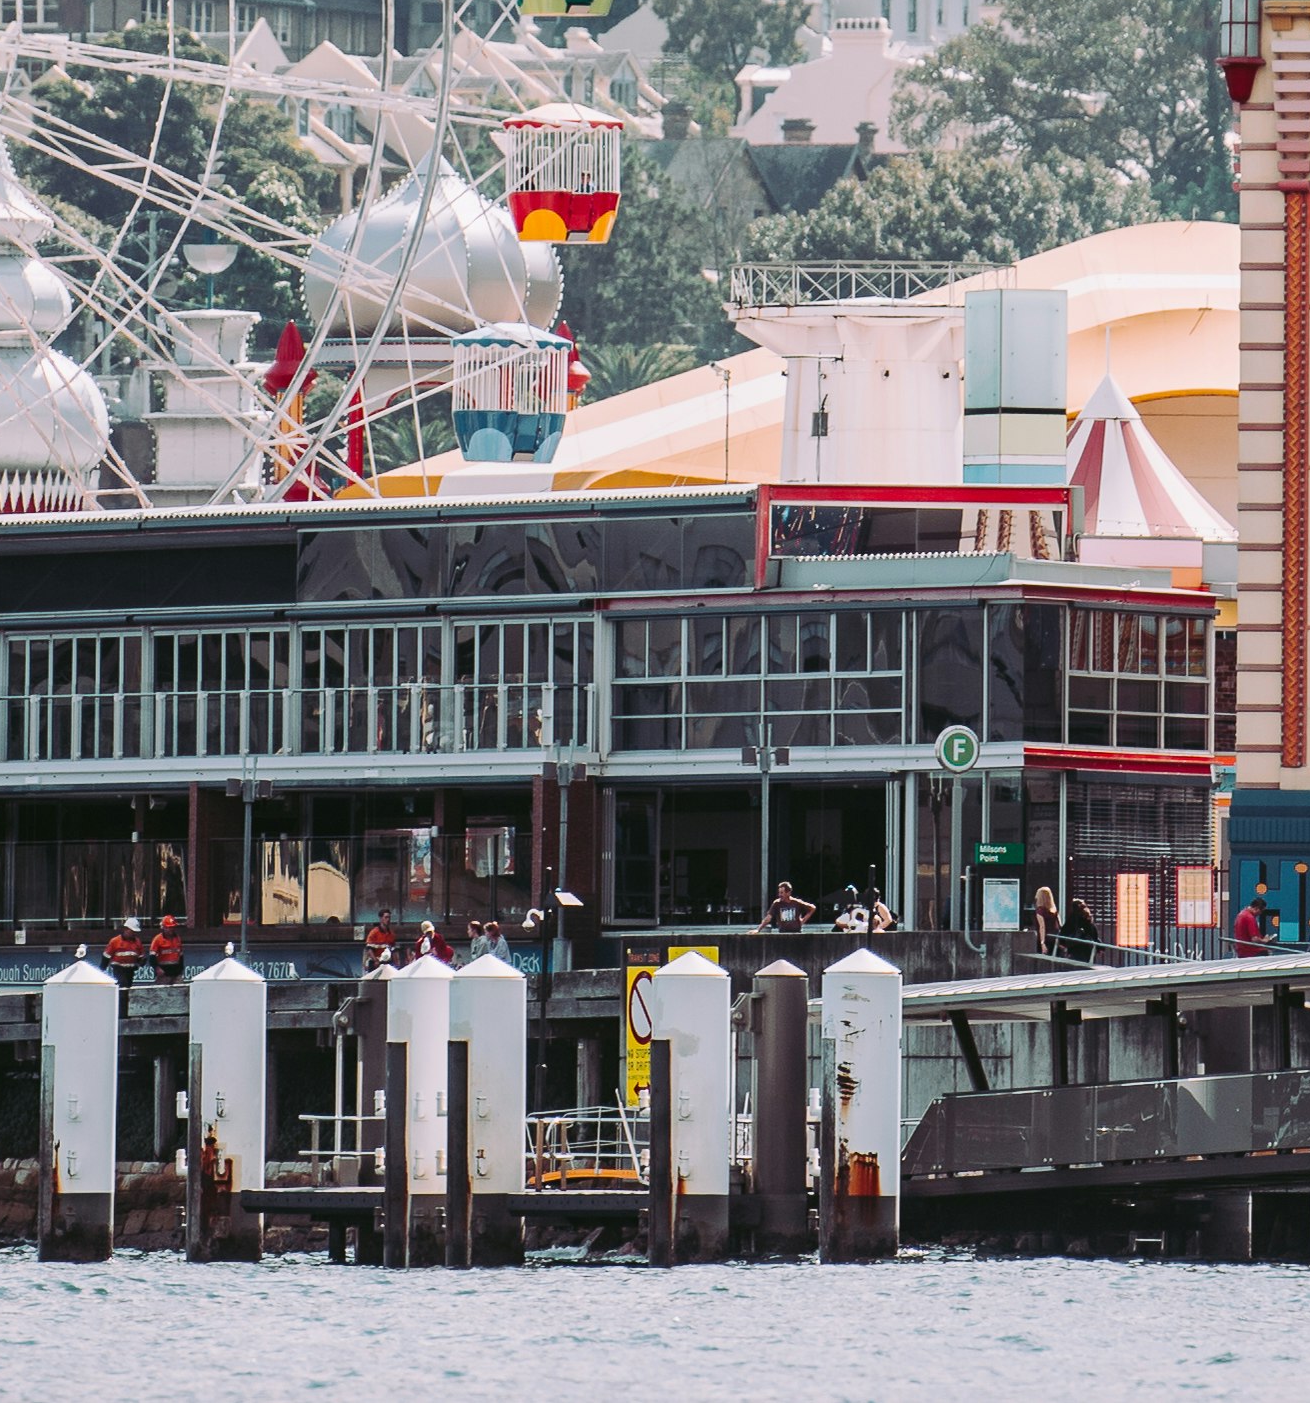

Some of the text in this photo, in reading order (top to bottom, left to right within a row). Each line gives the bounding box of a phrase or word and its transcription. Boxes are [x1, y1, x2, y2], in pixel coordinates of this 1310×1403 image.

[953, 738, 967, 762] F
[979, 845, 1007, 854] Milsons
[979, 854, 999, 863] Point
[268, 961, 291, 979] 7670
